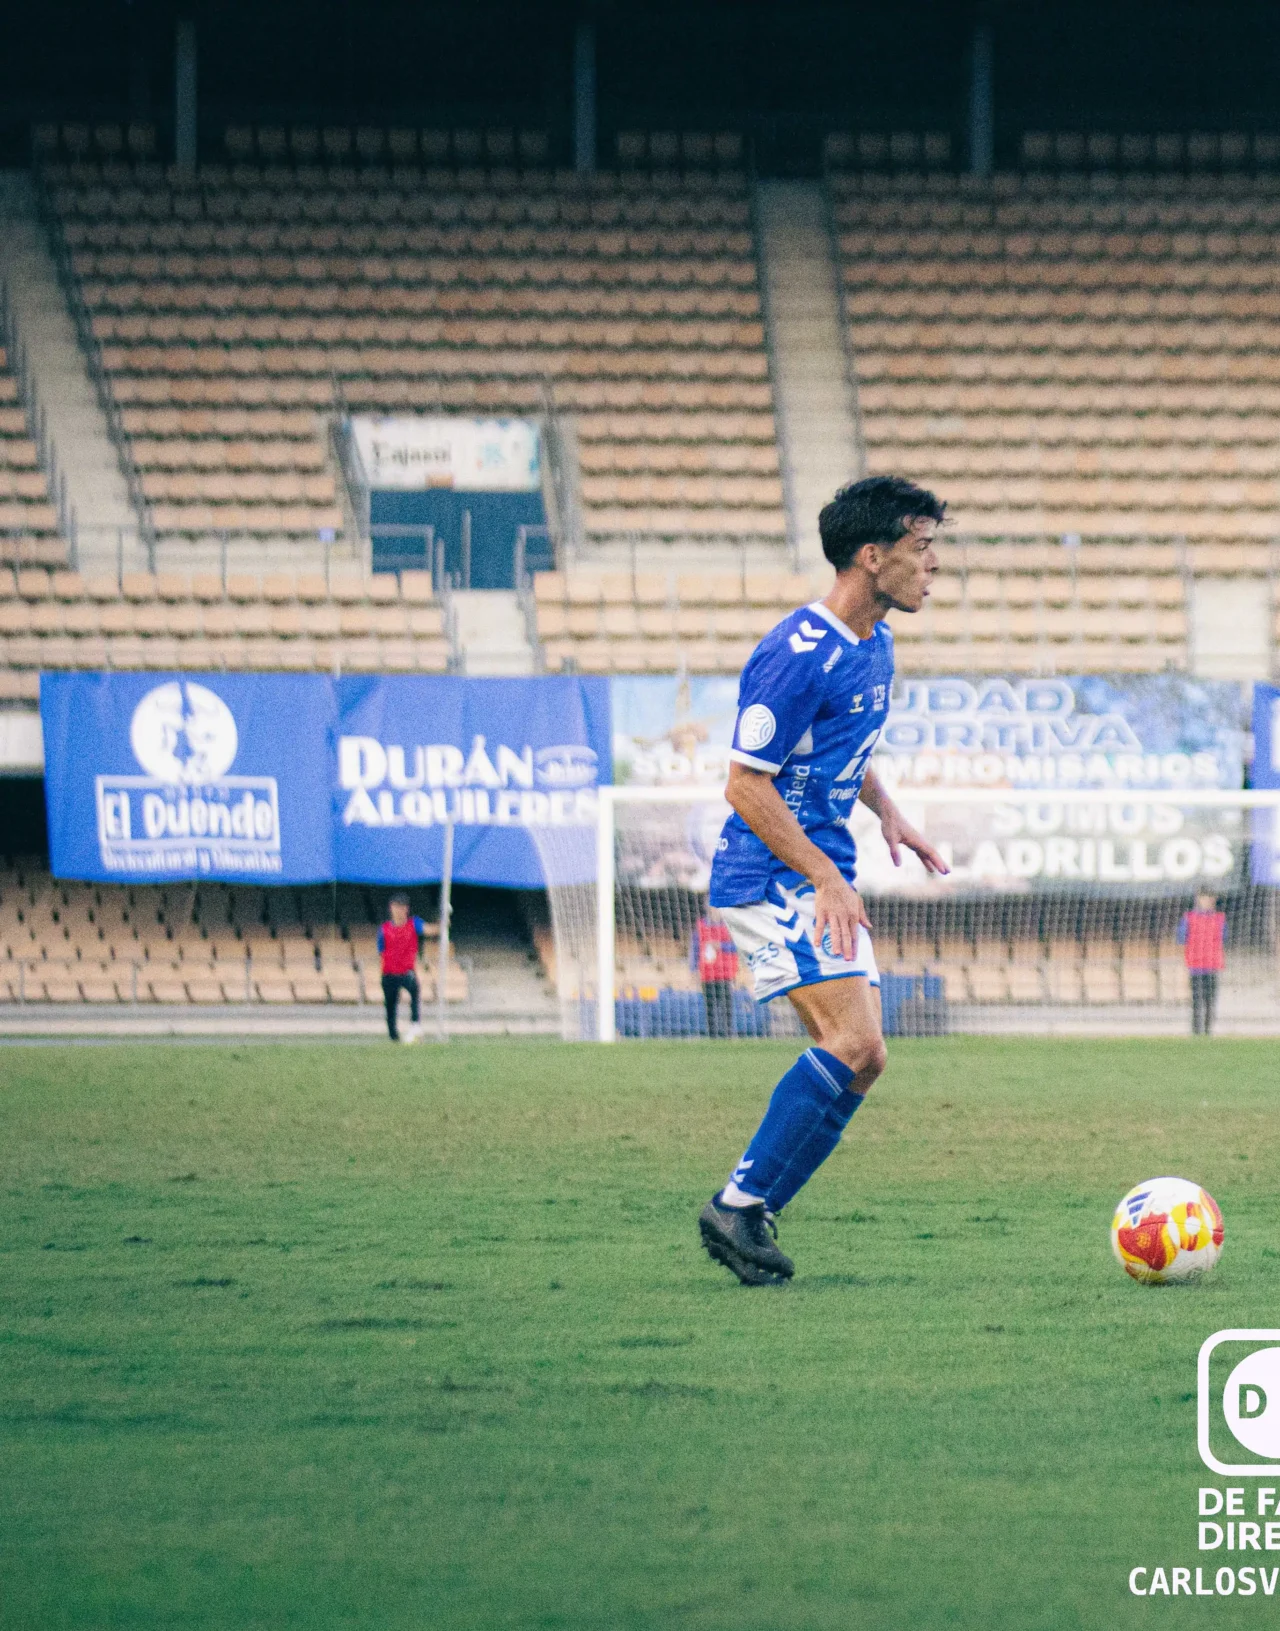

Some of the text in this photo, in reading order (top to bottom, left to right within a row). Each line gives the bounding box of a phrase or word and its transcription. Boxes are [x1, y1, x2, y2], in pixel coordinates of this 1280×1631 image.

[890, 679, 1076, 714] UDAD
[882, 713, 1144, 751] ORTIVA
[338, 734, 534, 790] DURÁN
[872, 752, 1219, 781] MPROMISARIOS
[105, 791, 132, 840] El
[343, 786, 600, 828] ALQUILERES
[992, 801, 1184, 834] SOMOS
